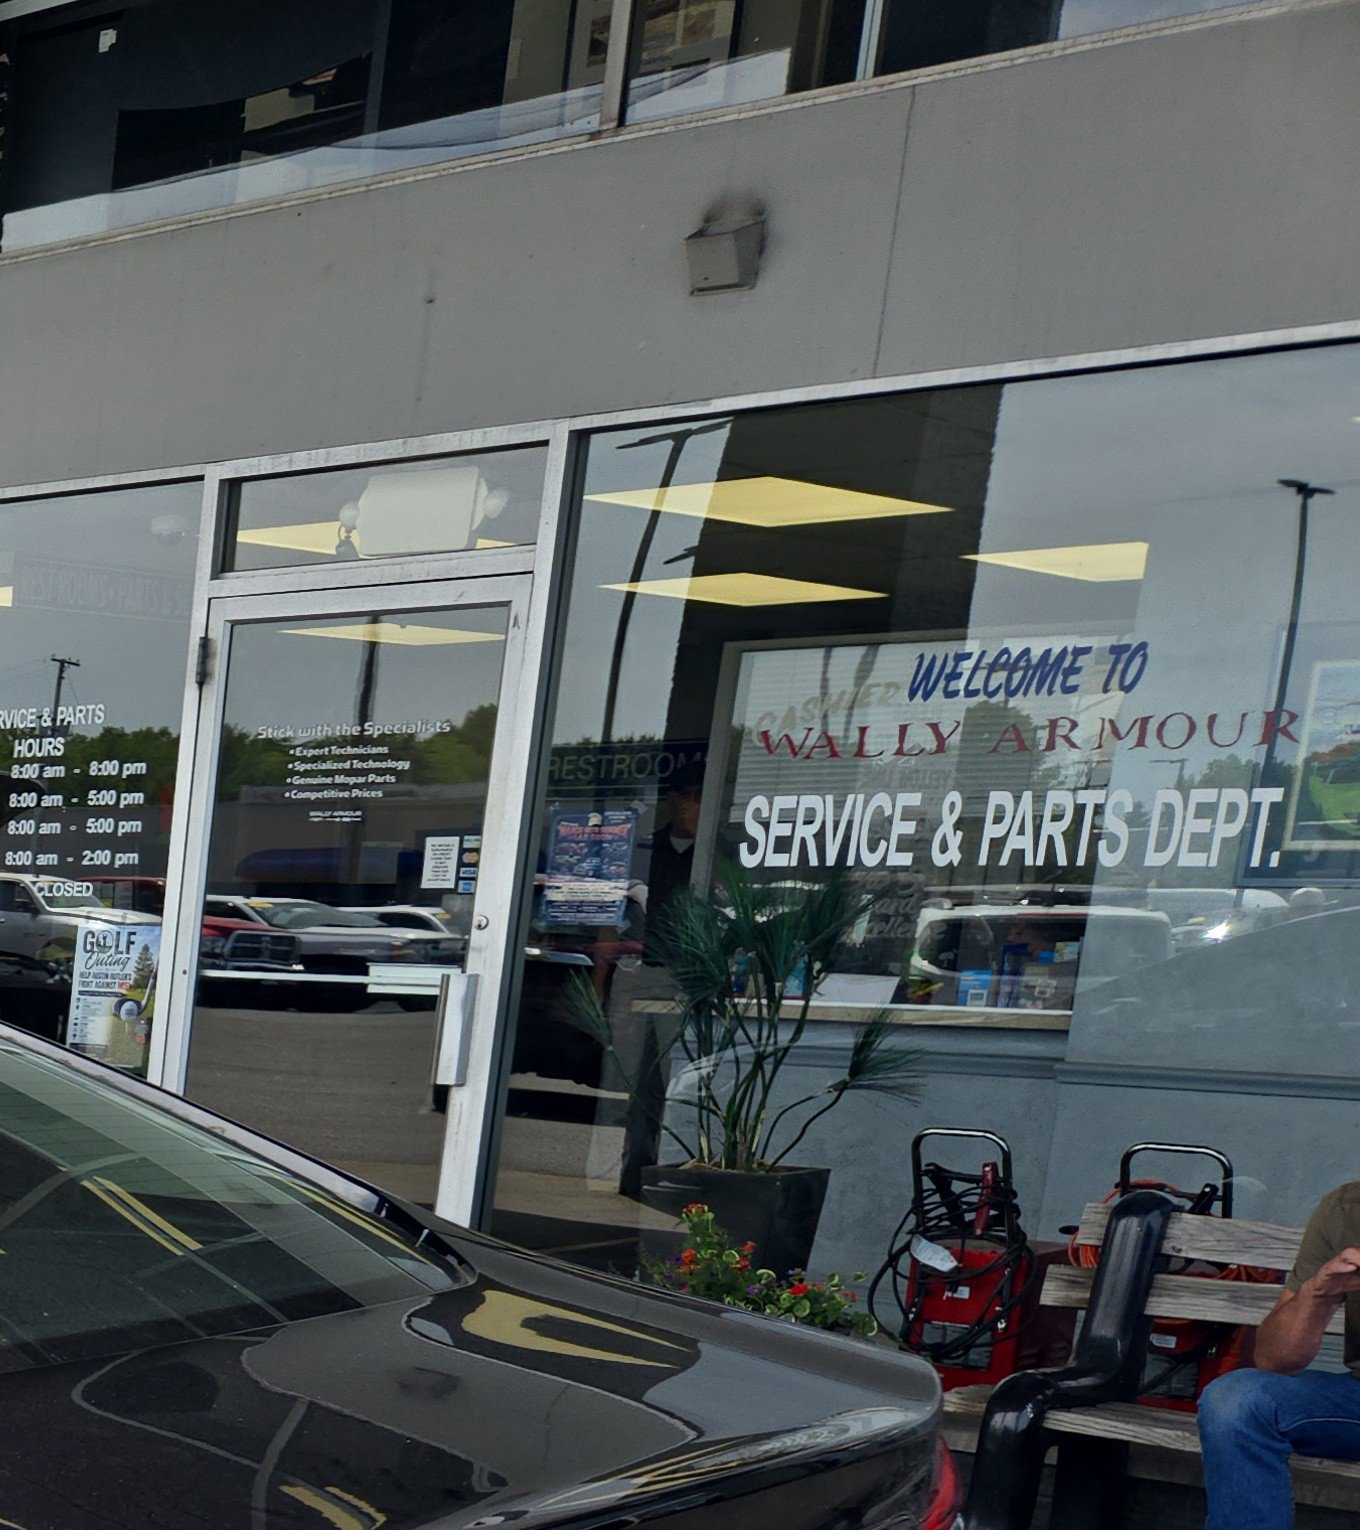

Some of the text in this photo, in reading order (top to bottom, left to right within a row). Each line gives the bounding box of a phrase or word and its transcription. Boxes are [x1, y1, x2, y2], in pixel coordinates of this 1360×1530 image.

[907, 641, 1149, 703] WELCOME TO
[40, 707, 52, 727] &
[56, 704, 106, 726] PARTS
[257, 720, 452, 739] Stick with the Specialists
[759, 707, 1300, 760] WALLY ARMOUR
[12, 736, 65, 759] HOURS
[295, 744, 389, 758] Expert Technicians
[10, 764, 39, 779] 8:00
[42, 765, 66, 778] am
[88, 760, 119, 776] 8:00
[122, 761, 147, 778] pm
[293, 758, 411, 772] Specialized Technology
[292, 773, 396, 786] Genuine Mopar Parts
[8, 792, 37, 808] 8:00
[40, 793, 63, 807] am
[86, 789, 117, 806] 5:00
[119, 790, 145, 808] pm
[290, 787, 383, 801] Competitive Prices
[7, 819, 35, 835] 8:00
[38, 821, 61, 834] am
[85, 818, 114, 834] 5:00
[117, 819, 143, 836] pm
[739, 786, 1285, 869] SERVICE & PARTS DEPT.
[5, 850, 32, 866] 8:00
[35, 852, 58, 866] am
[81, 850, 111, 865] 2:00
[114, 851, 139, 868] pm
[35, 881, 93, 898] CLOSED
[83, 929, 137, 955] GOLF
